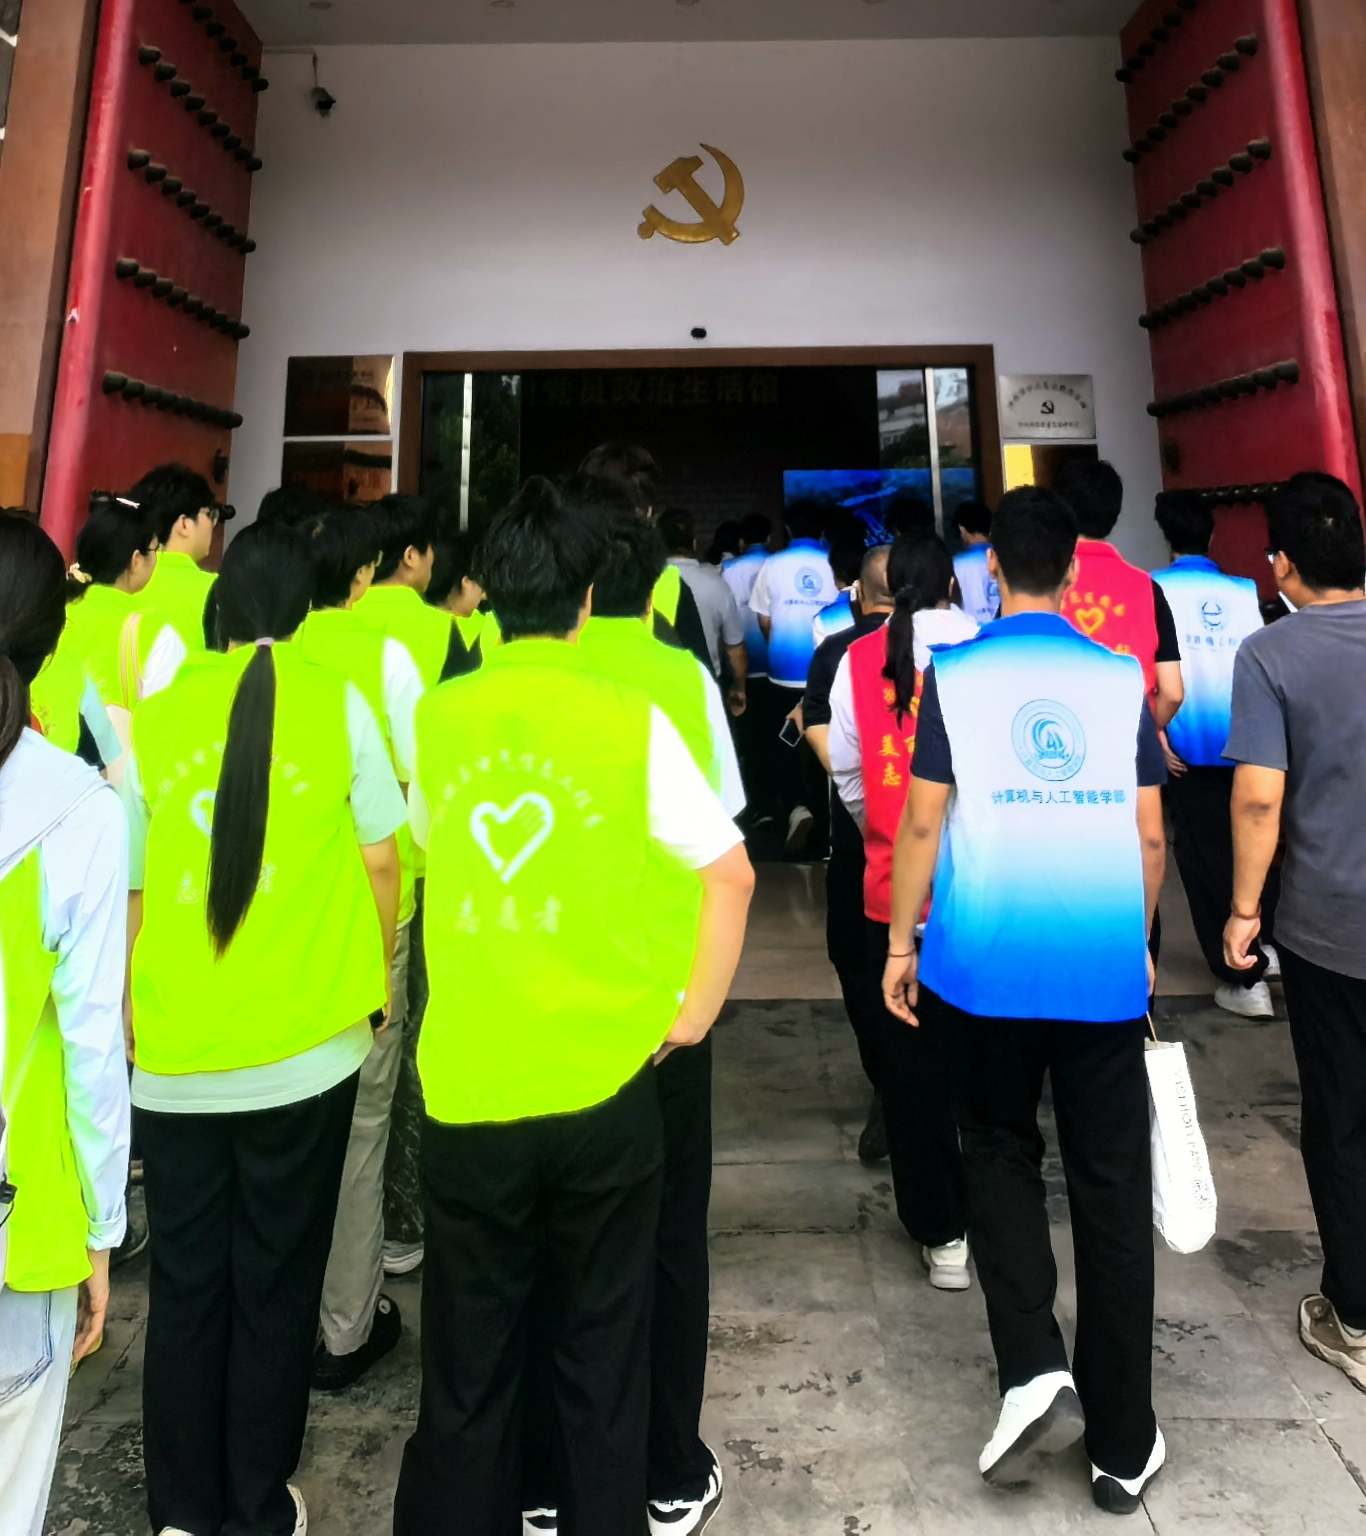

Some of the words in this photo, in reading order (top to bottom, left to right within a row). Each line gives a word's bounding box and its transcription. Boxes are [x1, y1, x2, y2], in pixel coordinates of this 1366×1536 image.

[991, 789, 1126, 805] 计算机与人工智能学部
